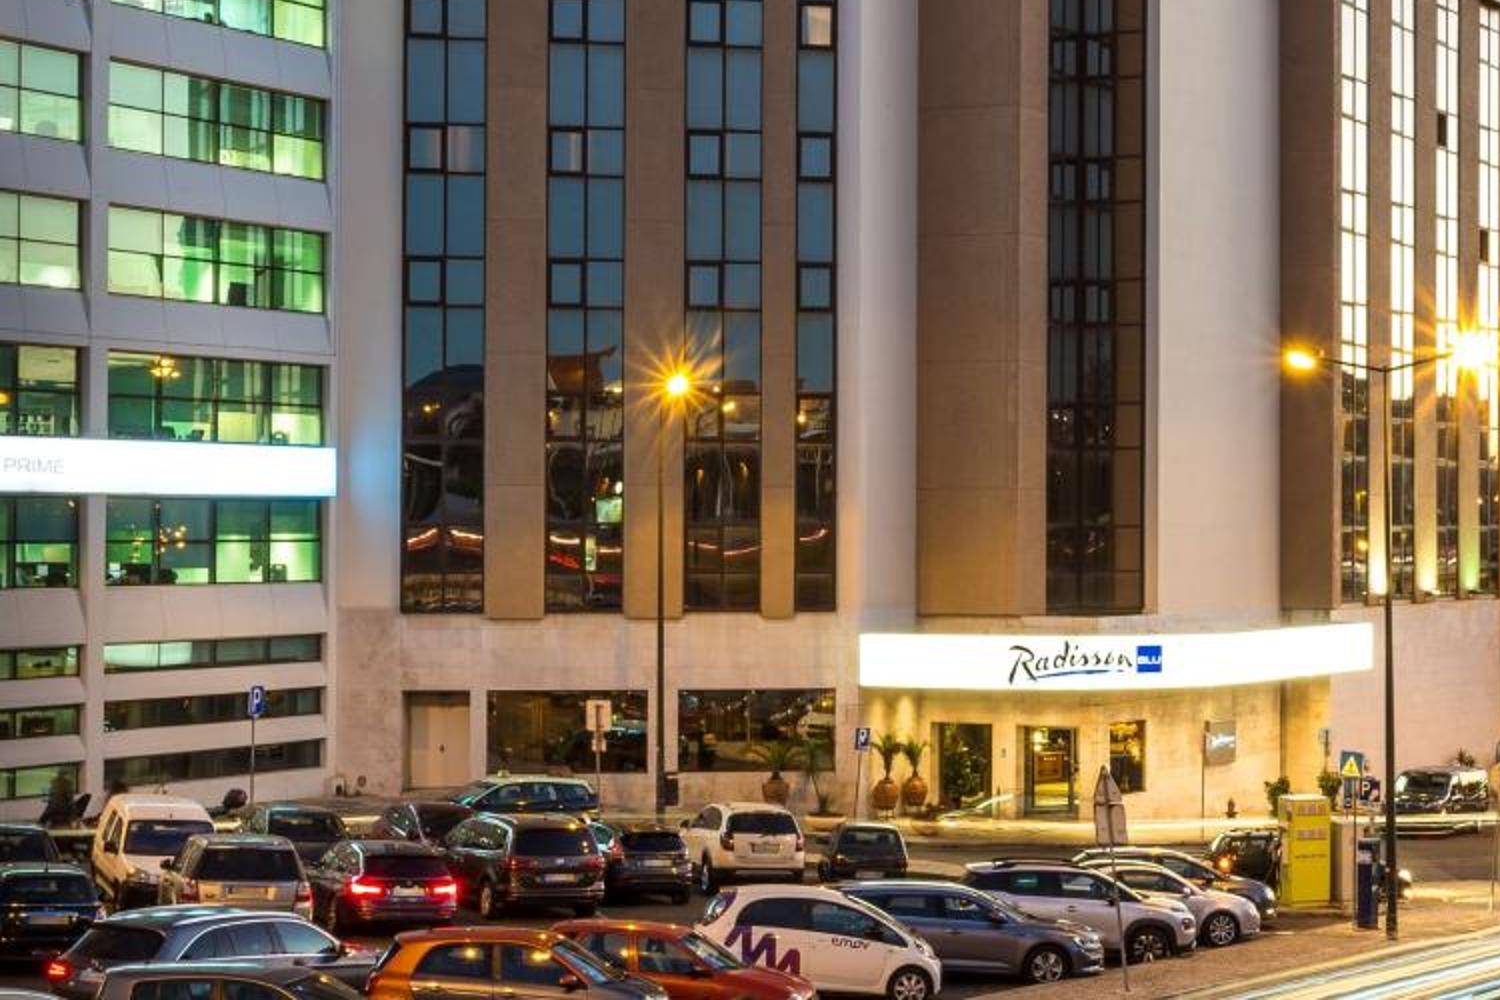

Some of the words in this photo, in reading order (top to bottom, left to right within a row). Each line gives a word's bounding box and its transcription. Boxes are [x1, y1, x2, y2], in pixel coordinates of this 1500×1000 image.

[3, 456, 65, 473] PRIME
[1008, 640, 1133, 685] Radisson
[1137, 655, 1161, 665] BLU
